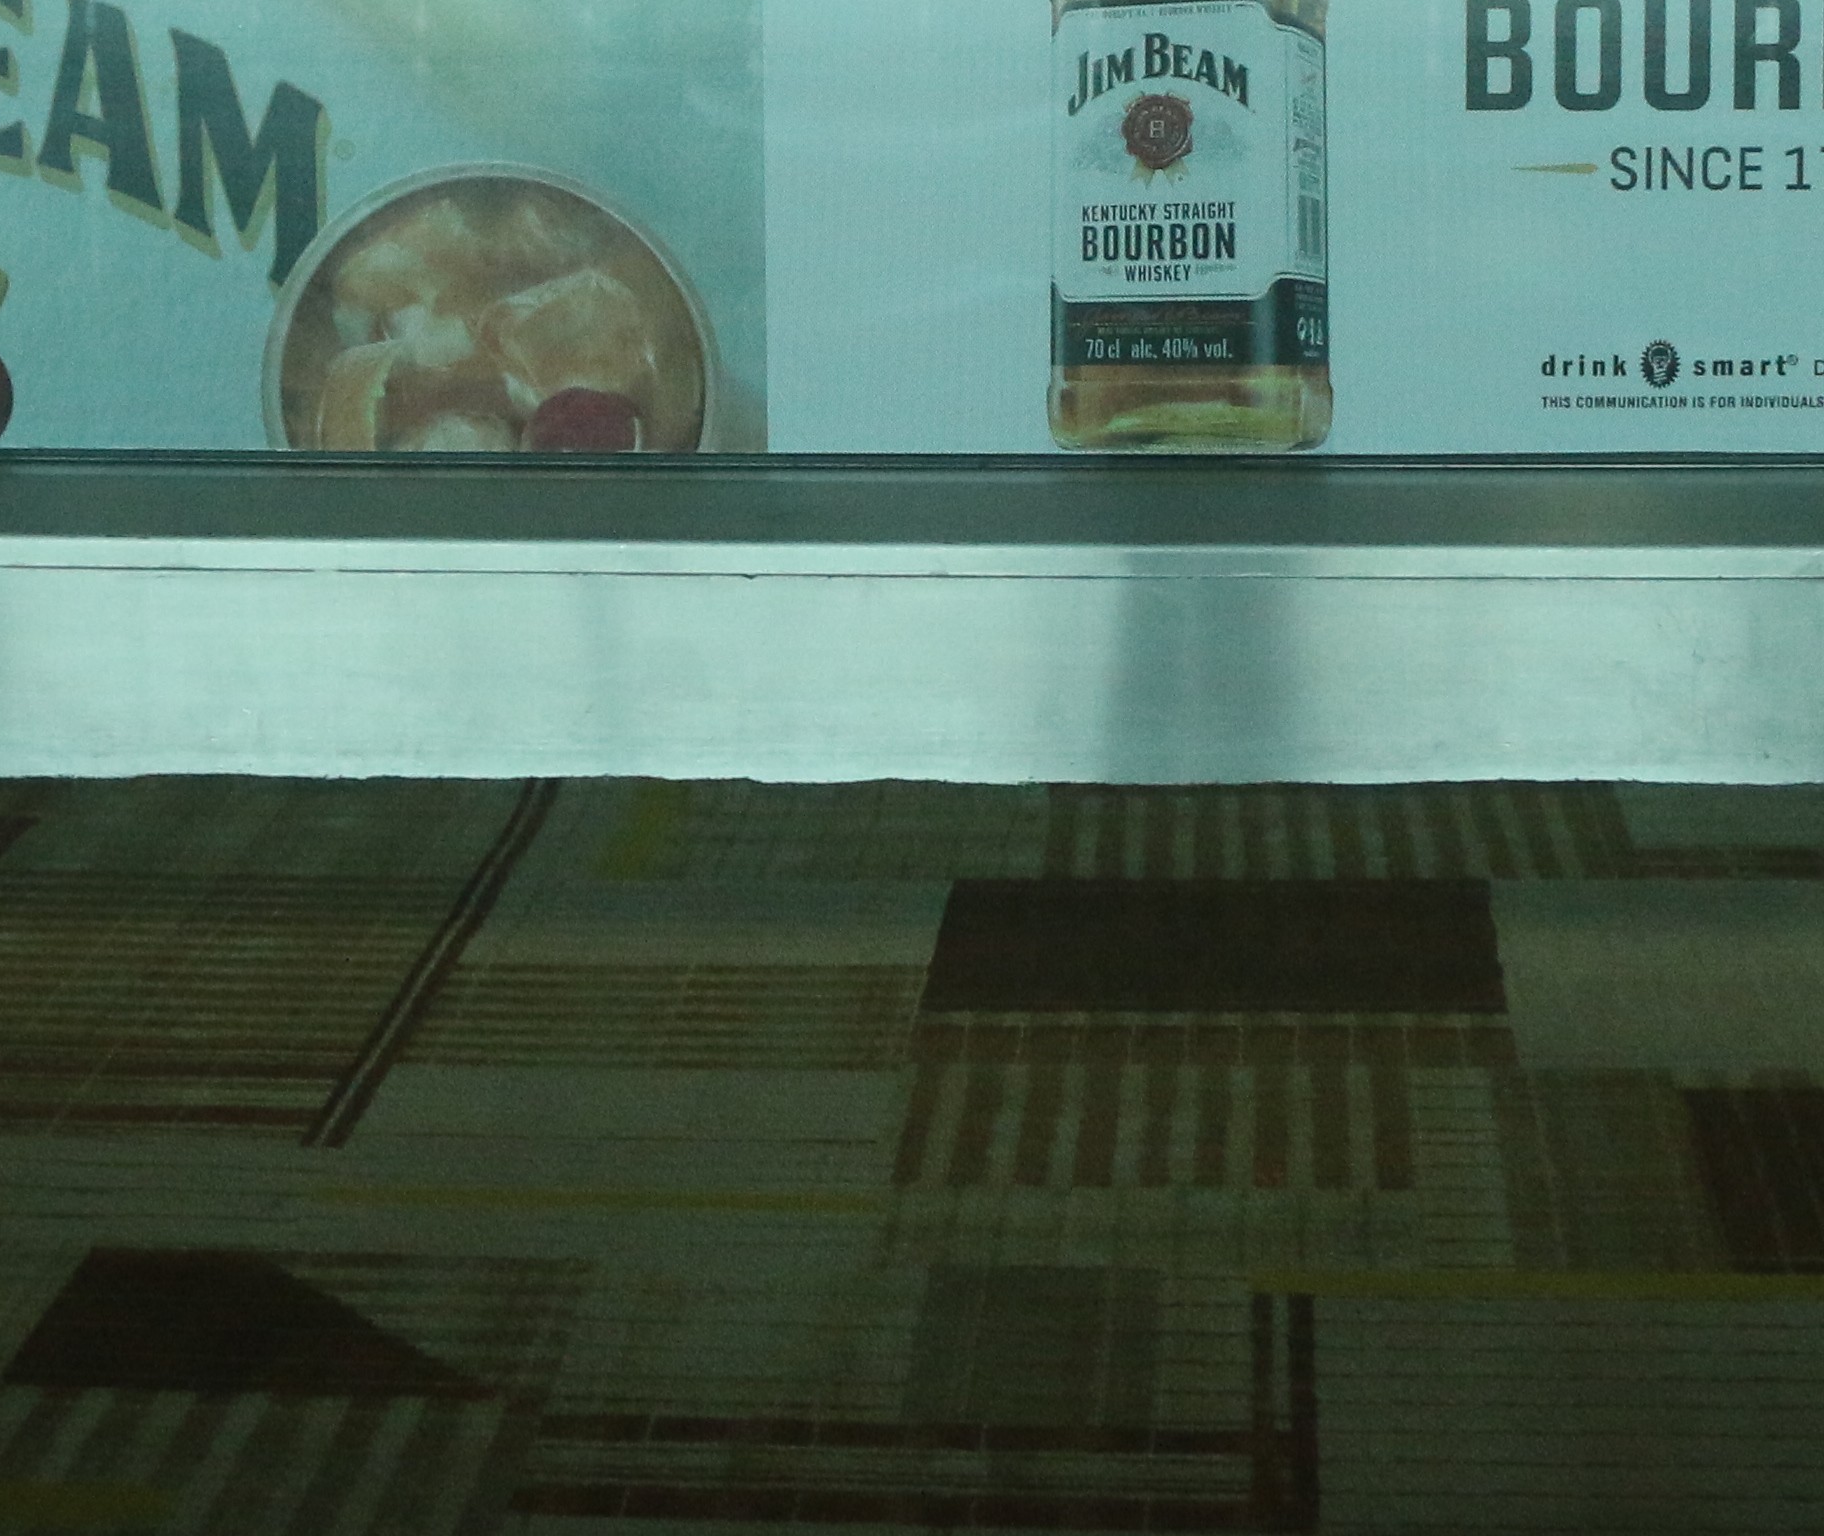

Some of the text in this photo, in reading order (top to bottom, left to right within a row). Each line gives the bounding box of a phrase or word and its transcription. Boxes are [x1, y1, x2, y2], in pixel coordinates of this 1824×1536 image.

[1067, 46, 1135, 117] JIM
[1143, 32, 1251, 109] BEAM
[1609, 145, 1764, 191] SINCE
[1082, 201, 1236, 222] KENTUCKY STRAIGHT
[1082, 222, 1236, 262] BOURBON
[1125, 264, 1192, 282] WHISKEY
[1162, 338, 1198, 359] 40%
[1204, 338, 1234, 359] vol.
[1541, 354, 1629, 377] drink
[1541, 396, 1571, 409] THIS
[1576, 396, 1688, 409] COMMUNICATION
[1692, 396, 1706, 409] IS
[1710, 396, 1736, 409] FOR
[1740, 396, 1824, 409] INDIVIDUALS
